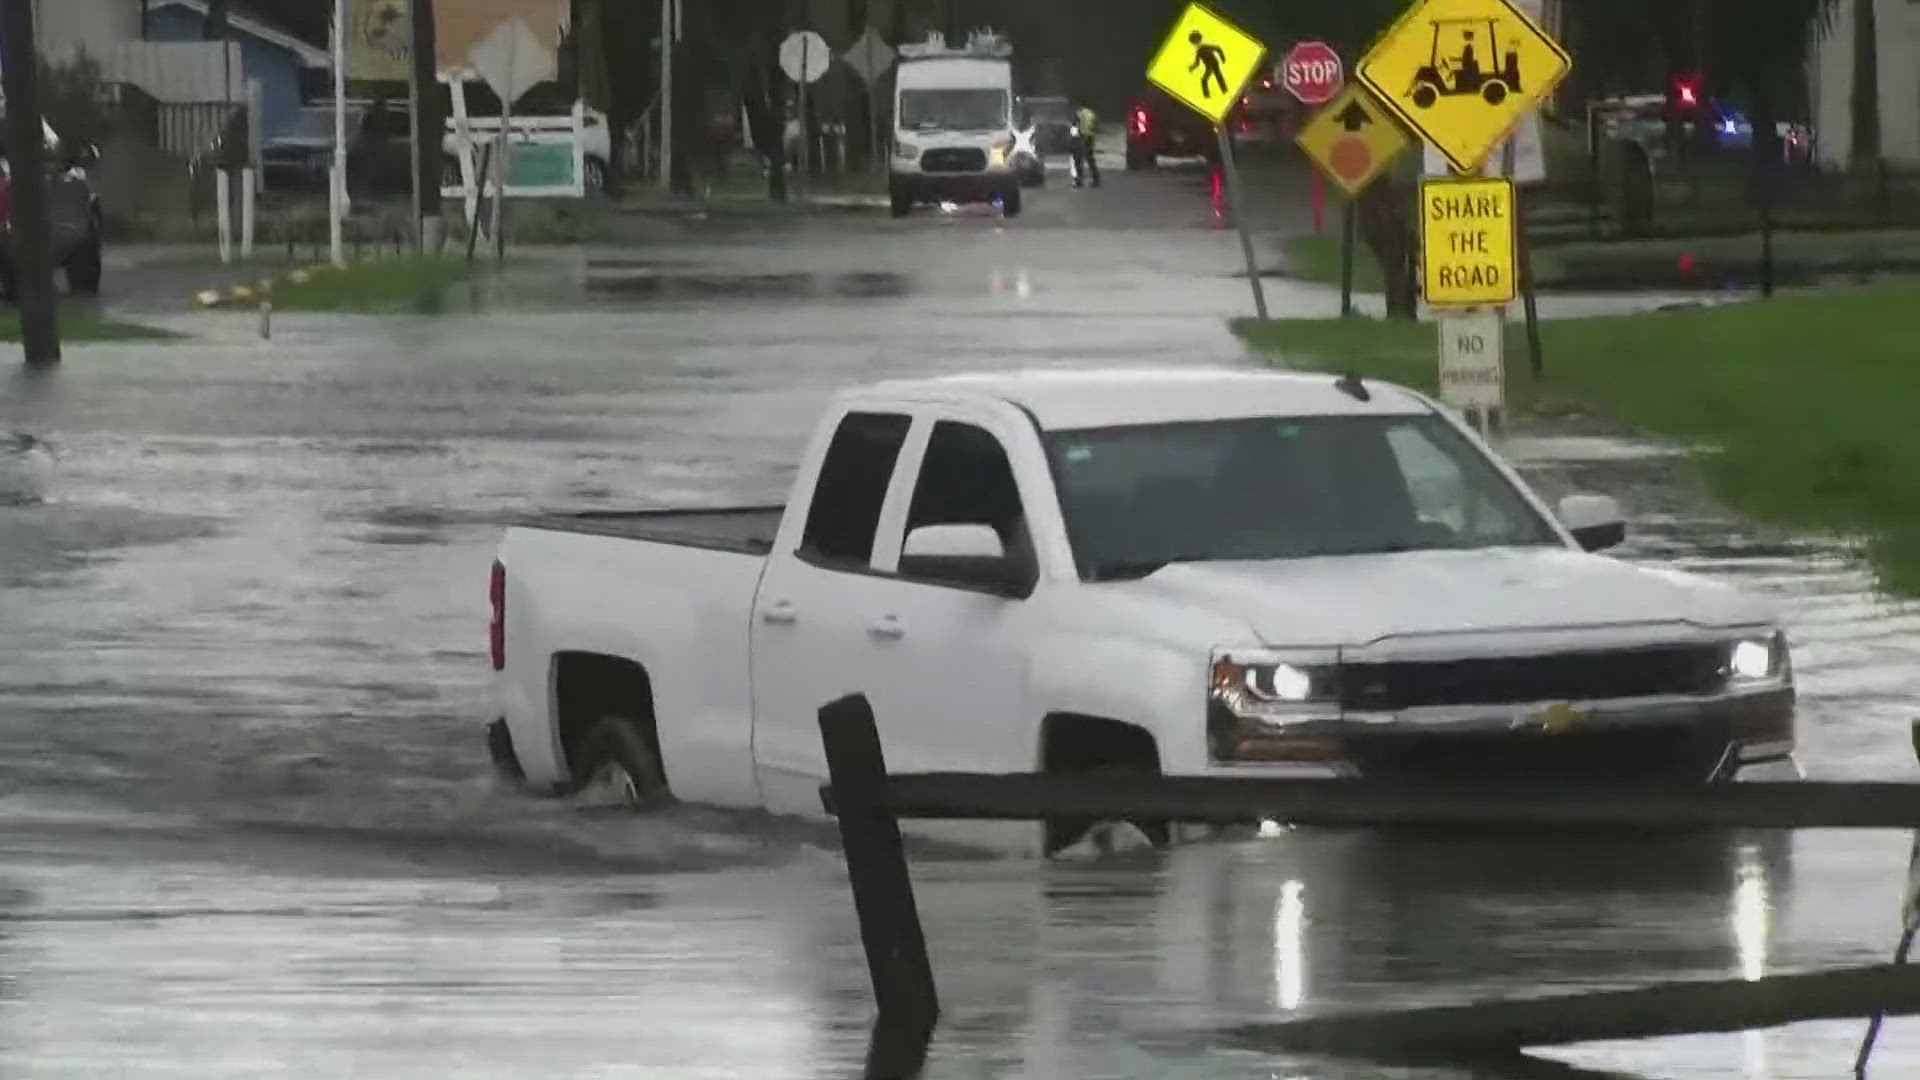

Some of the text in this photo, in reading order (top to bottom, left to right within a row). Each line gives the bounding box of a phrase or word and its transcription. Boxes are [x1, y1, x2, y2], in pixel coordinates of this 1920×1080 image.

[1289, 60, 1337, 84] STOP
[1431, 196, 1503, 220] SHARE
[1448, 231, 1489, 253] THE
[1440, 265, 1499, 289] ROAD
[1457, 335, 1485, 354] NO
